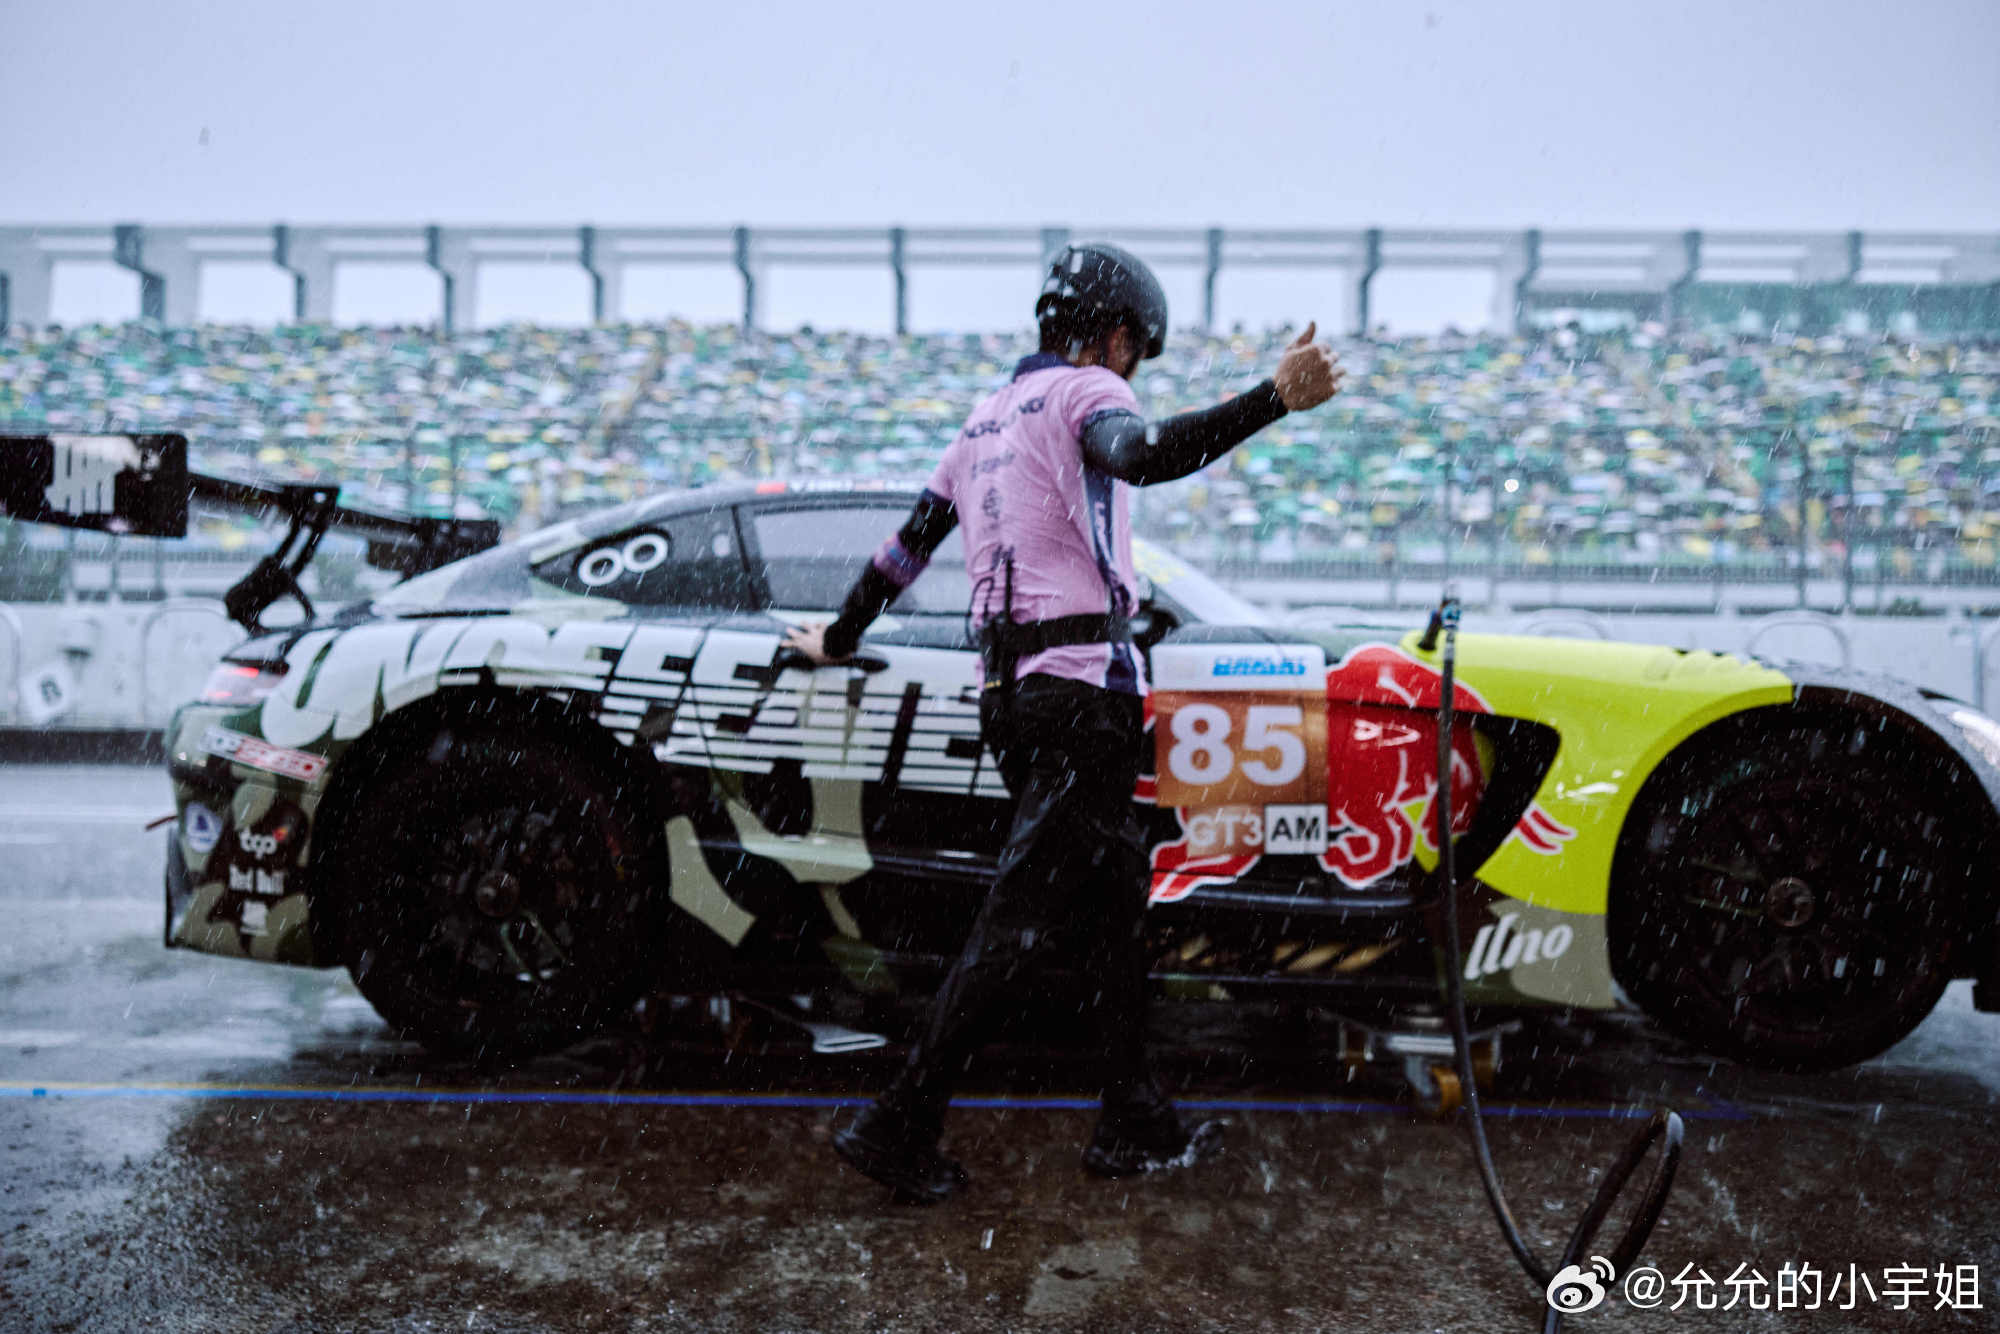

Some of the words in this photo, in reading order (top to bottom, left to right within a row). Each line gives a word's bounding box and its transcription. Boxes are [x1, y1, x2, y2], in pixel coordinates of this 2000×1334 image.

[1169, 703, 1306, 787] 85
[1187, 814, 1264, 848] GT3
[1271, 816, 1321, 843] AM
